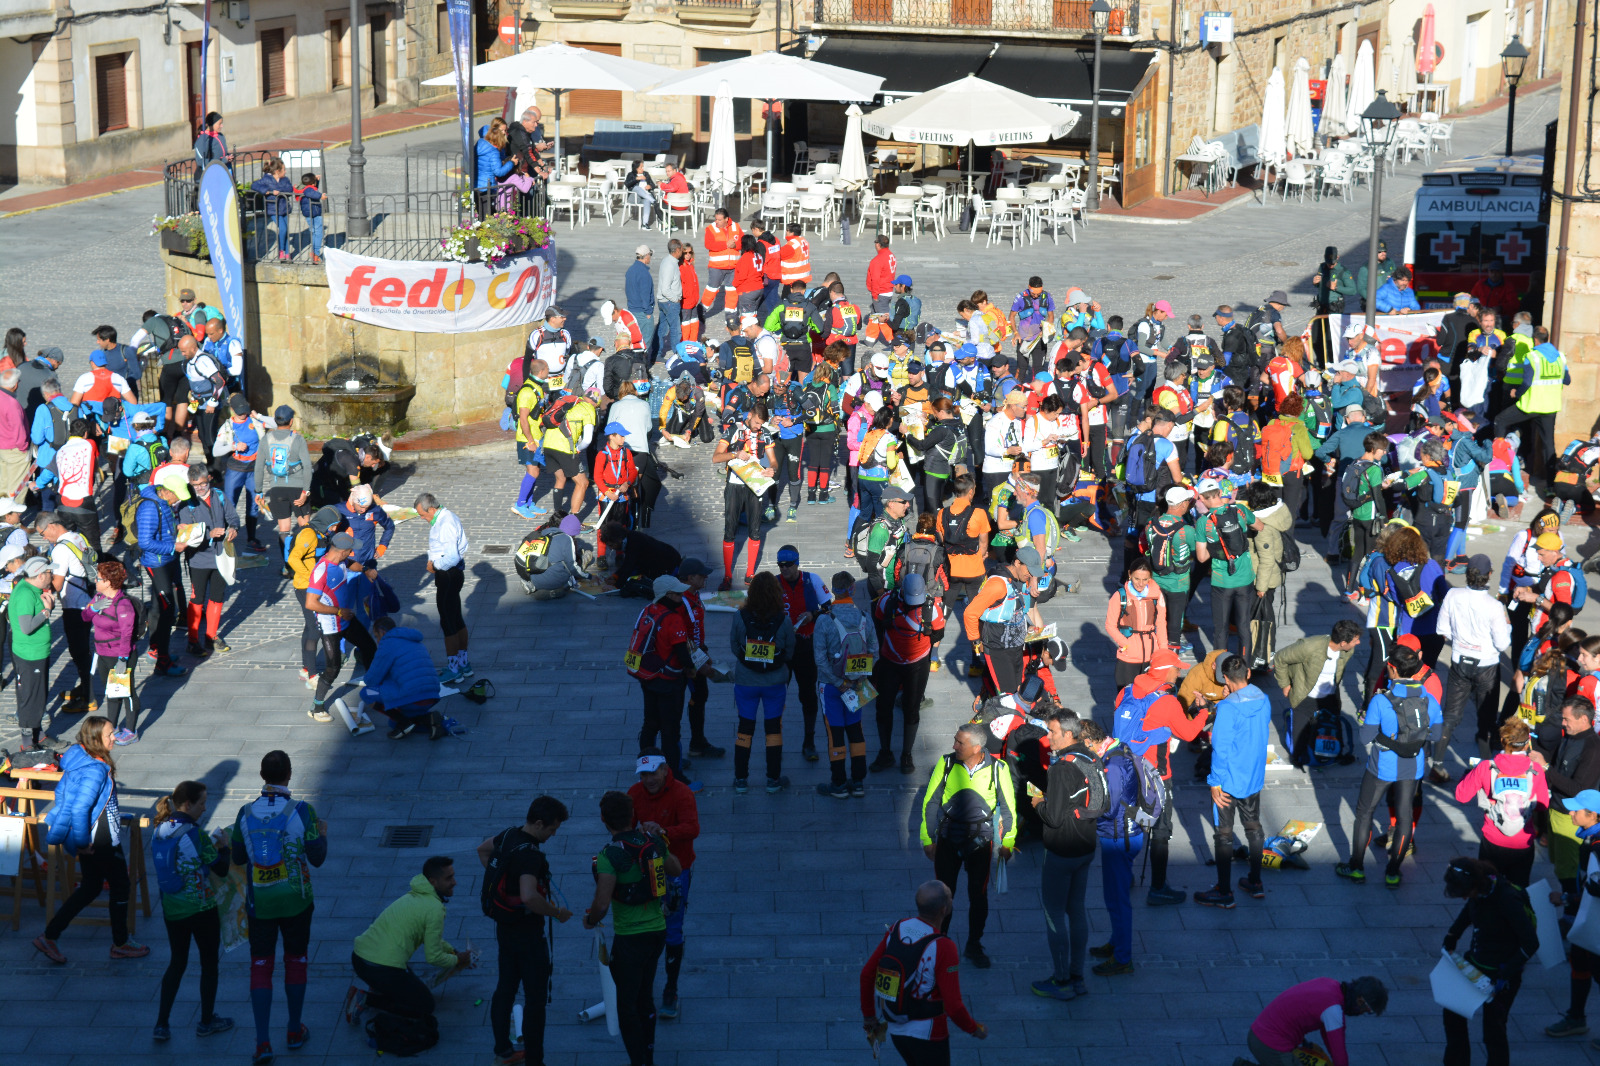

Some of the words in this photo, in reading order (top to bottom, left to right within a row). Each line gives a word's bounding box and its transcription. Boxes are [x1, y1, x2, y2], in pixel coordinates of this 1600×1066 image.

[919, 131, 954, 142] VELTINS
[999, 131, 1033, 142] VELTINS
[1428, 200, 1536, 213] AMBULANCIA
[1447, 487, 1456, 500] 217
[1409, 597, 1426, 612] 249
[751, 644, 769, 657] 245
[851, 658, 867, 670] 245
[1321, 739, 1336, 751] 103
[1500, 777, 1520, 789] 144
[258, 867, 281, 882] 229
[654, 864, 665, 889] 206
